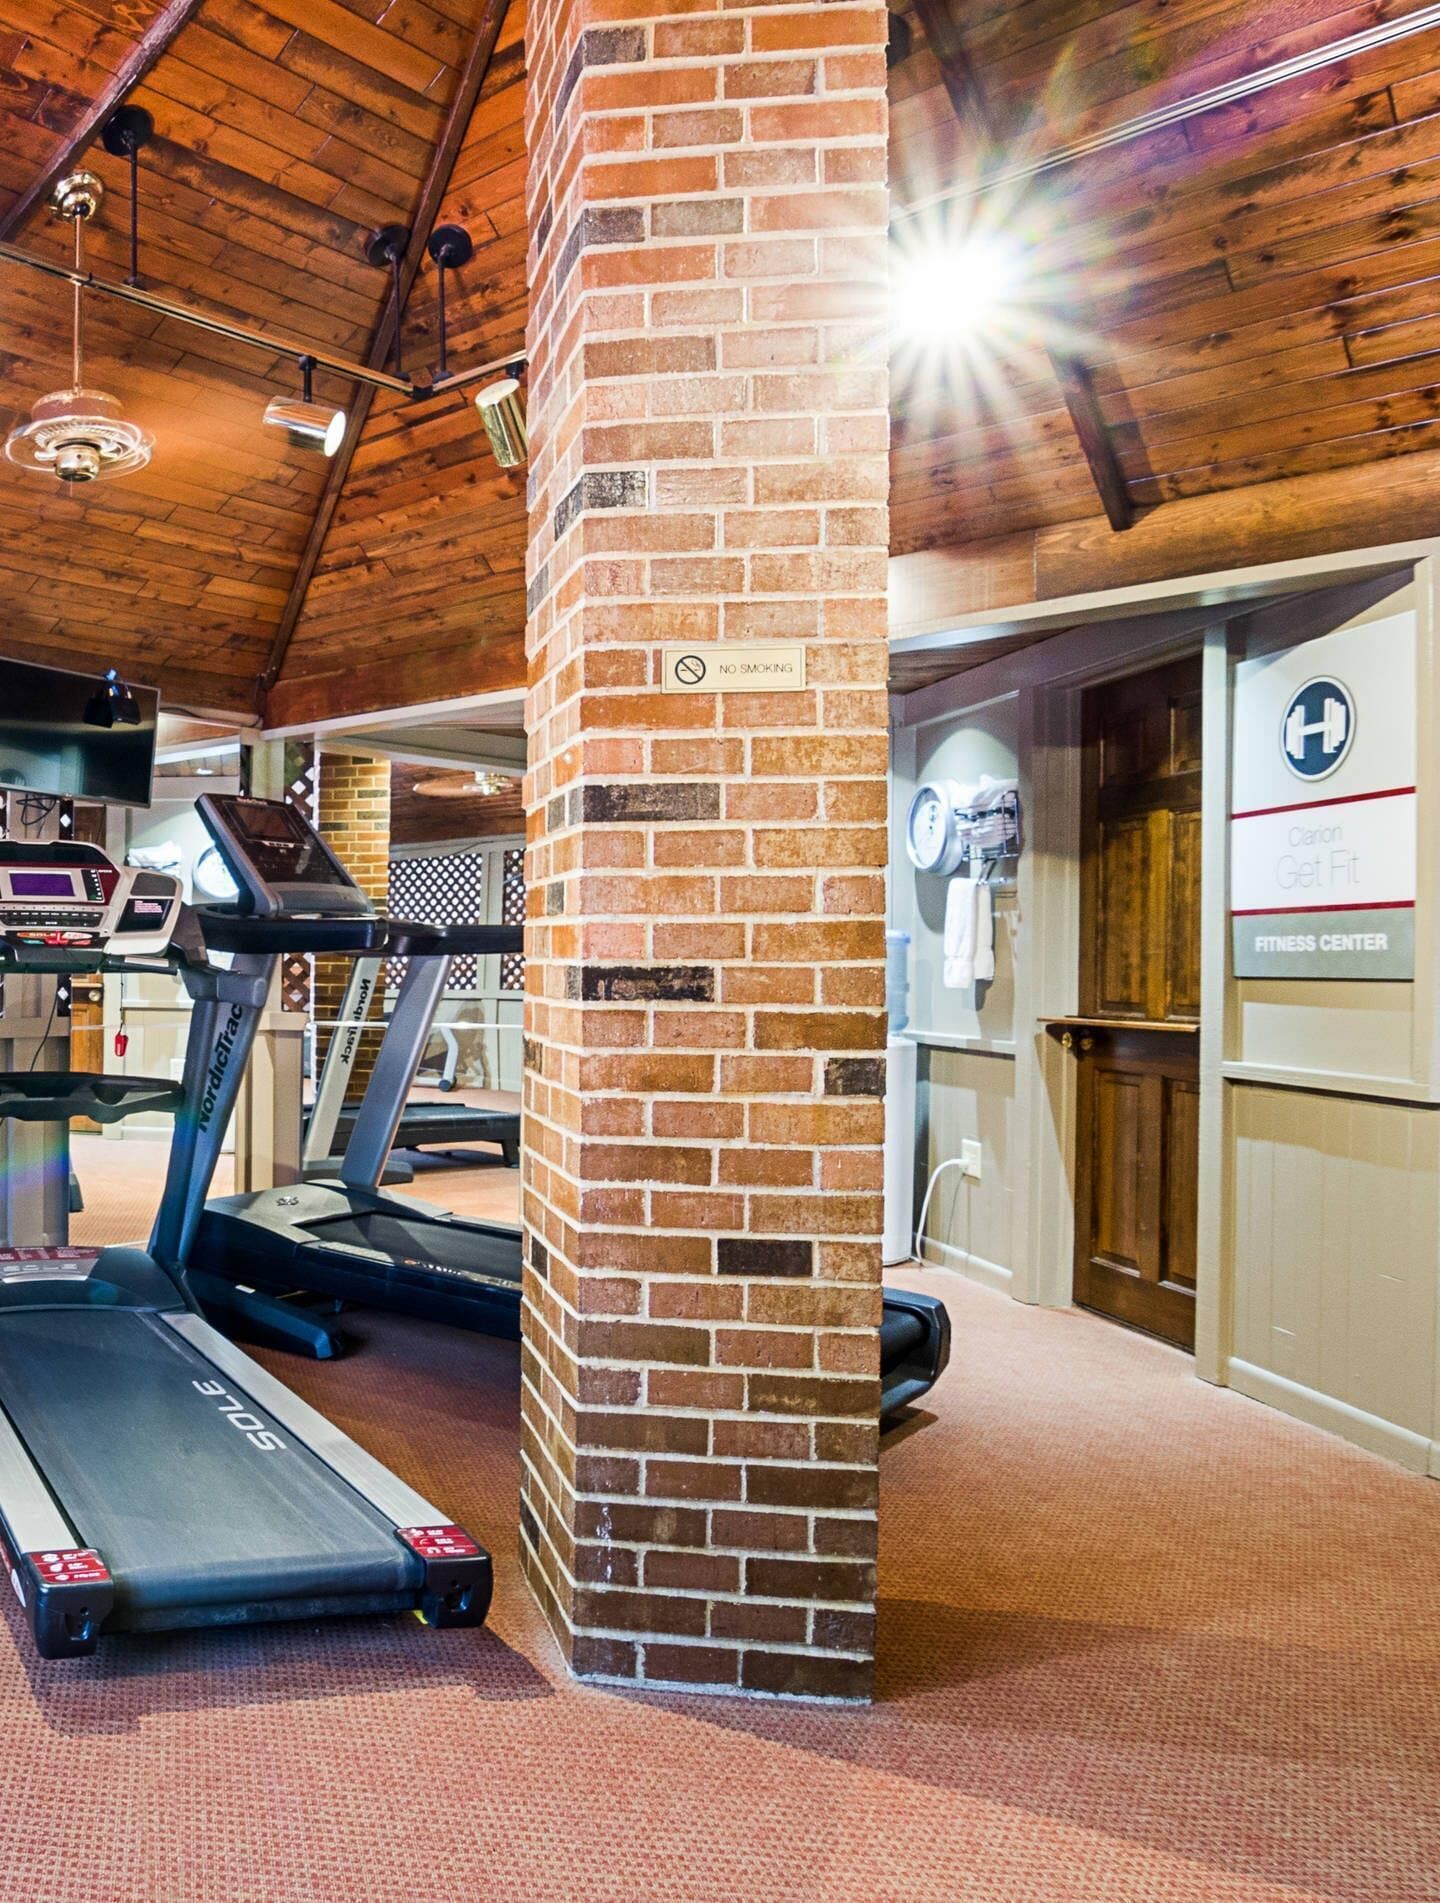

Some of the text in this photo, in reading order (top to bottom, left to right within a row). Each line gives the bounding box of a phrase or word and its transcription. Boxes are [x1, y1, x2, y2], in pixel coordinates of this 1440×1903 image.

[719, 663, 793, 674] NO SMOKING
[1288, 825, 1343, 847] Clarion
[1276, 849, 1360, 890] Get Fit
[1255, 933, 1388, 952] FITNESS CENTER
[198, 1004, 243, 1133] NordicTrac
[192, 1380, 287, 1451] SOLE
